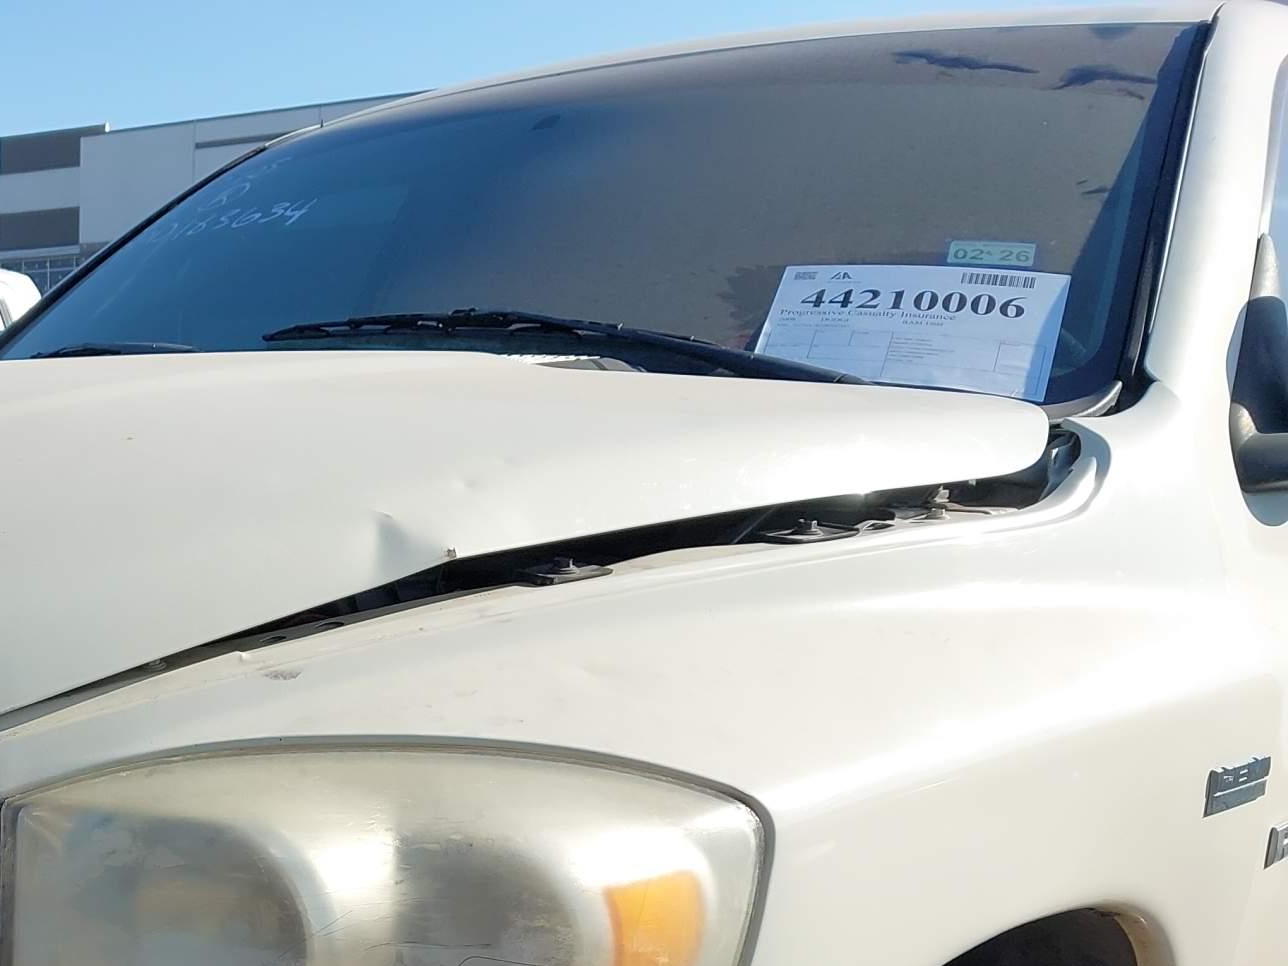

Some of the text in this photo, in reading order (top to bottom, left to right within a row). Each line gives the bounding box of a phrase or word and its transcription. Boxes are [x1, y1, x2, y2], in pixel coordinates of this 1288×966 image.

[953, 247, 1031, 263] 02 26
[799, 287, 1027, 319] 44210006
[779, 308, 958, 321] Progressive Casualty Insurance
